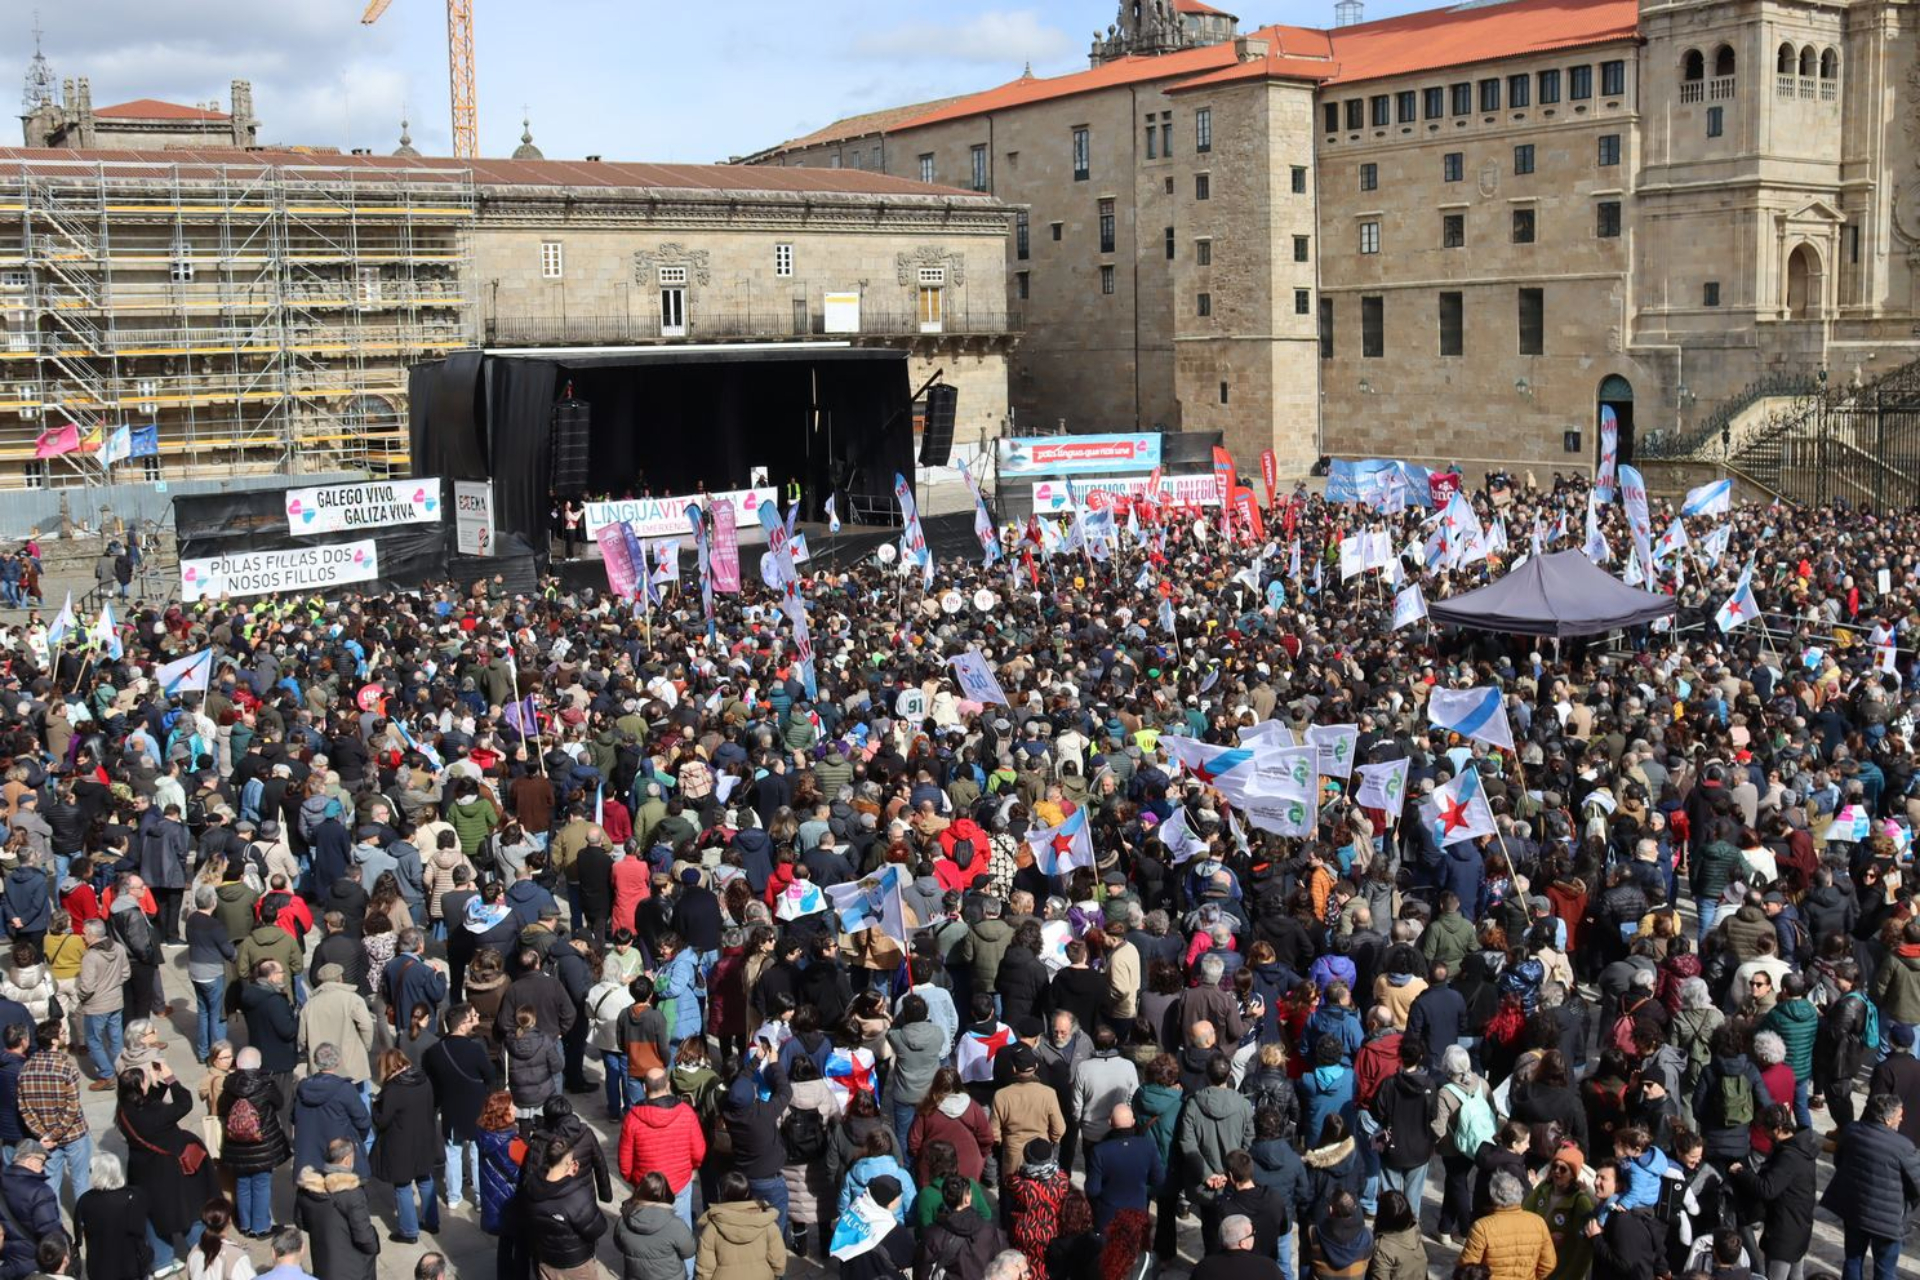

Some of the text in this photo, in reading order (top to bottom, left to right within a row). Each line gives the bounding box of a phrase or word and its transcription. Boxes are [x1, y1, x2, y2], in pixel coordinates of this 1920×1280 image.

[317, 488, 362, 508] GALEGO
[344, 503, 417, 525] GALIZA VIVA
[211, 548, 352, 575] POLAS FILLAS DOS
[228, 566, 336, 591] NOSOS FILLOS
[908, 697, 923, 714] 91
